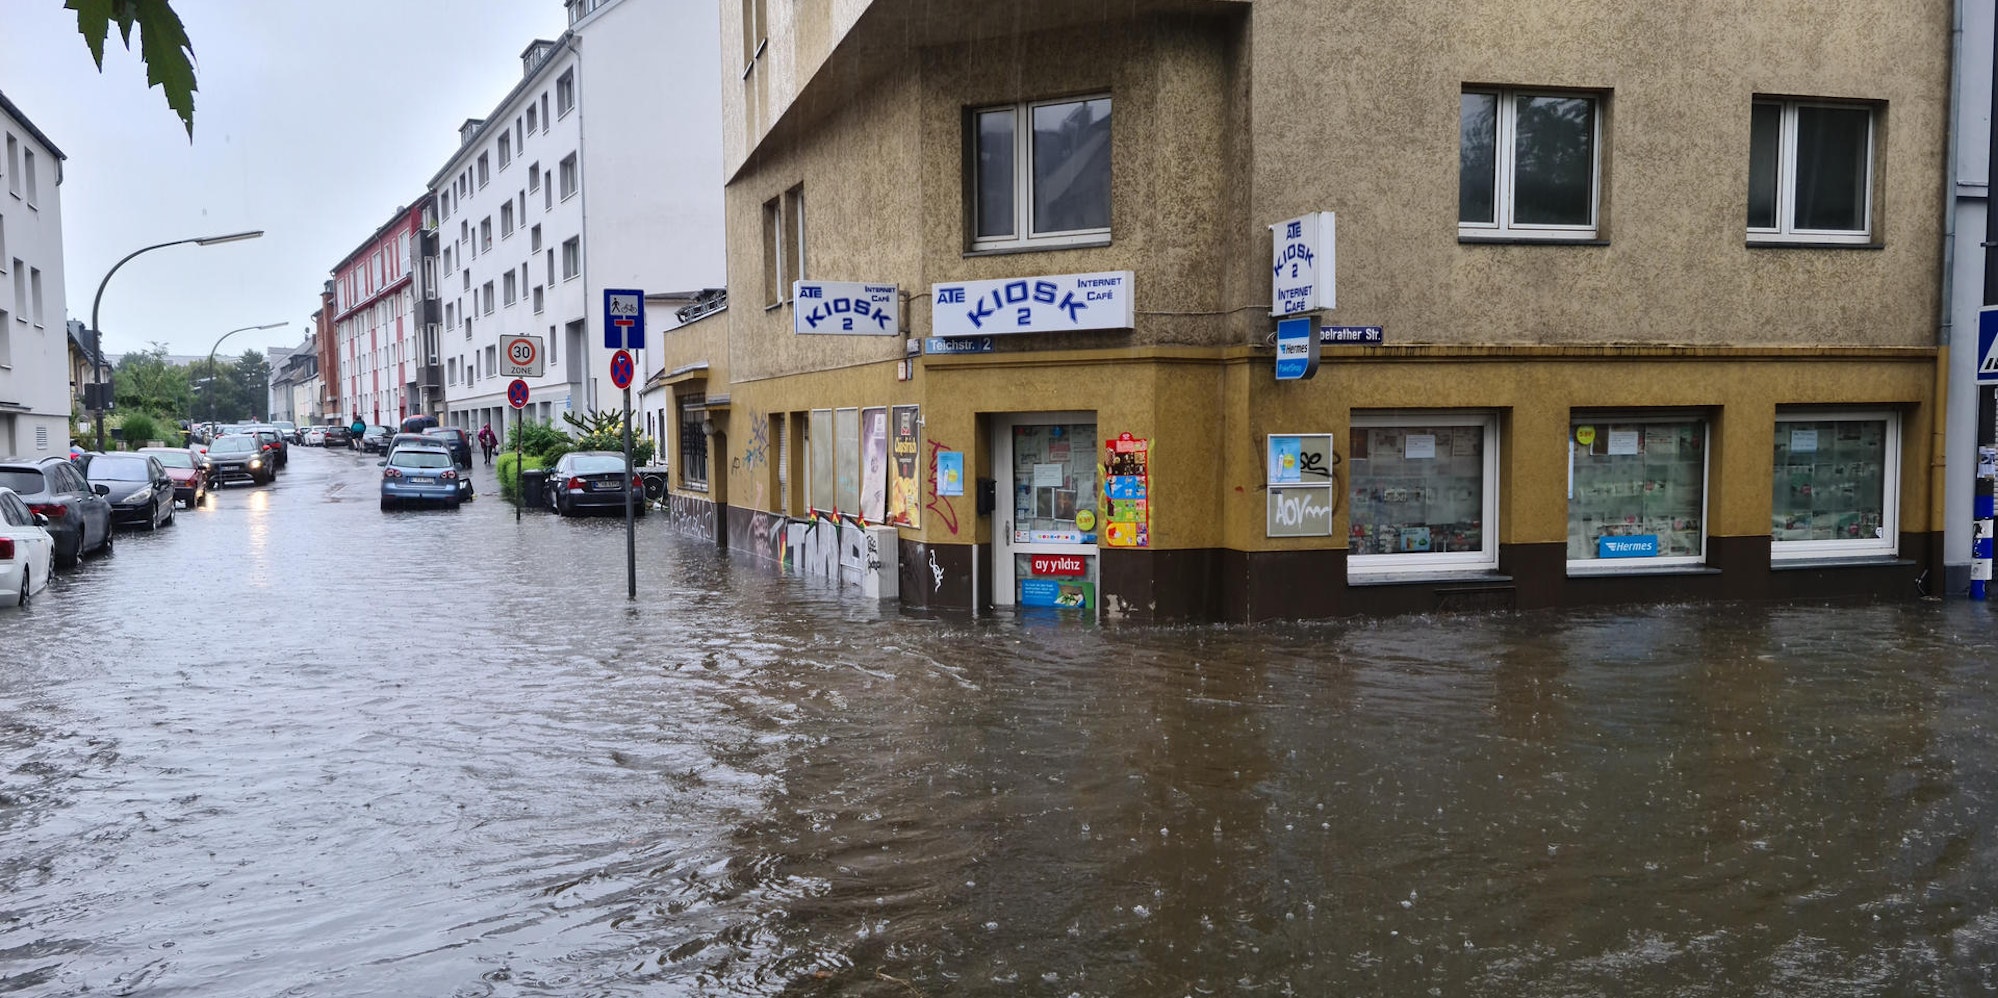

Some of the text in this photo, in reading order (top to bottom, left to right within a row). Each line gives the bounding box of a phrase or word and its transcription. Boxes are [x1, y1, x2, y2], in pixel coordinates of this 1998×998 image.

[1286, 221, 1301, 240] ATE
[1274, 243, 1314, 278] KIOSK
[1292, 263, 1298, 278] 2
[799, 286, 822, 298] ATE
[937, 287, 966, 304] ATE
[967, 280, 1089, 329] KIOSK
[805, 298, 892, 329] KIOSK
[1017, 307, 1032, 326] 2
[843, 318, 853, 330] 2
[1366, 328, 1381, 341] Str.
[930, 338, 991, 351] Teichstr. 2
[1285, 344, 1308, 354] Hermes
[513, 346, 530, 358] 30
[511, 366, 532, 374] ZONE
[1616, 541, 1652, 552] Hermes
[1035, 560, 1049, 573] ay
